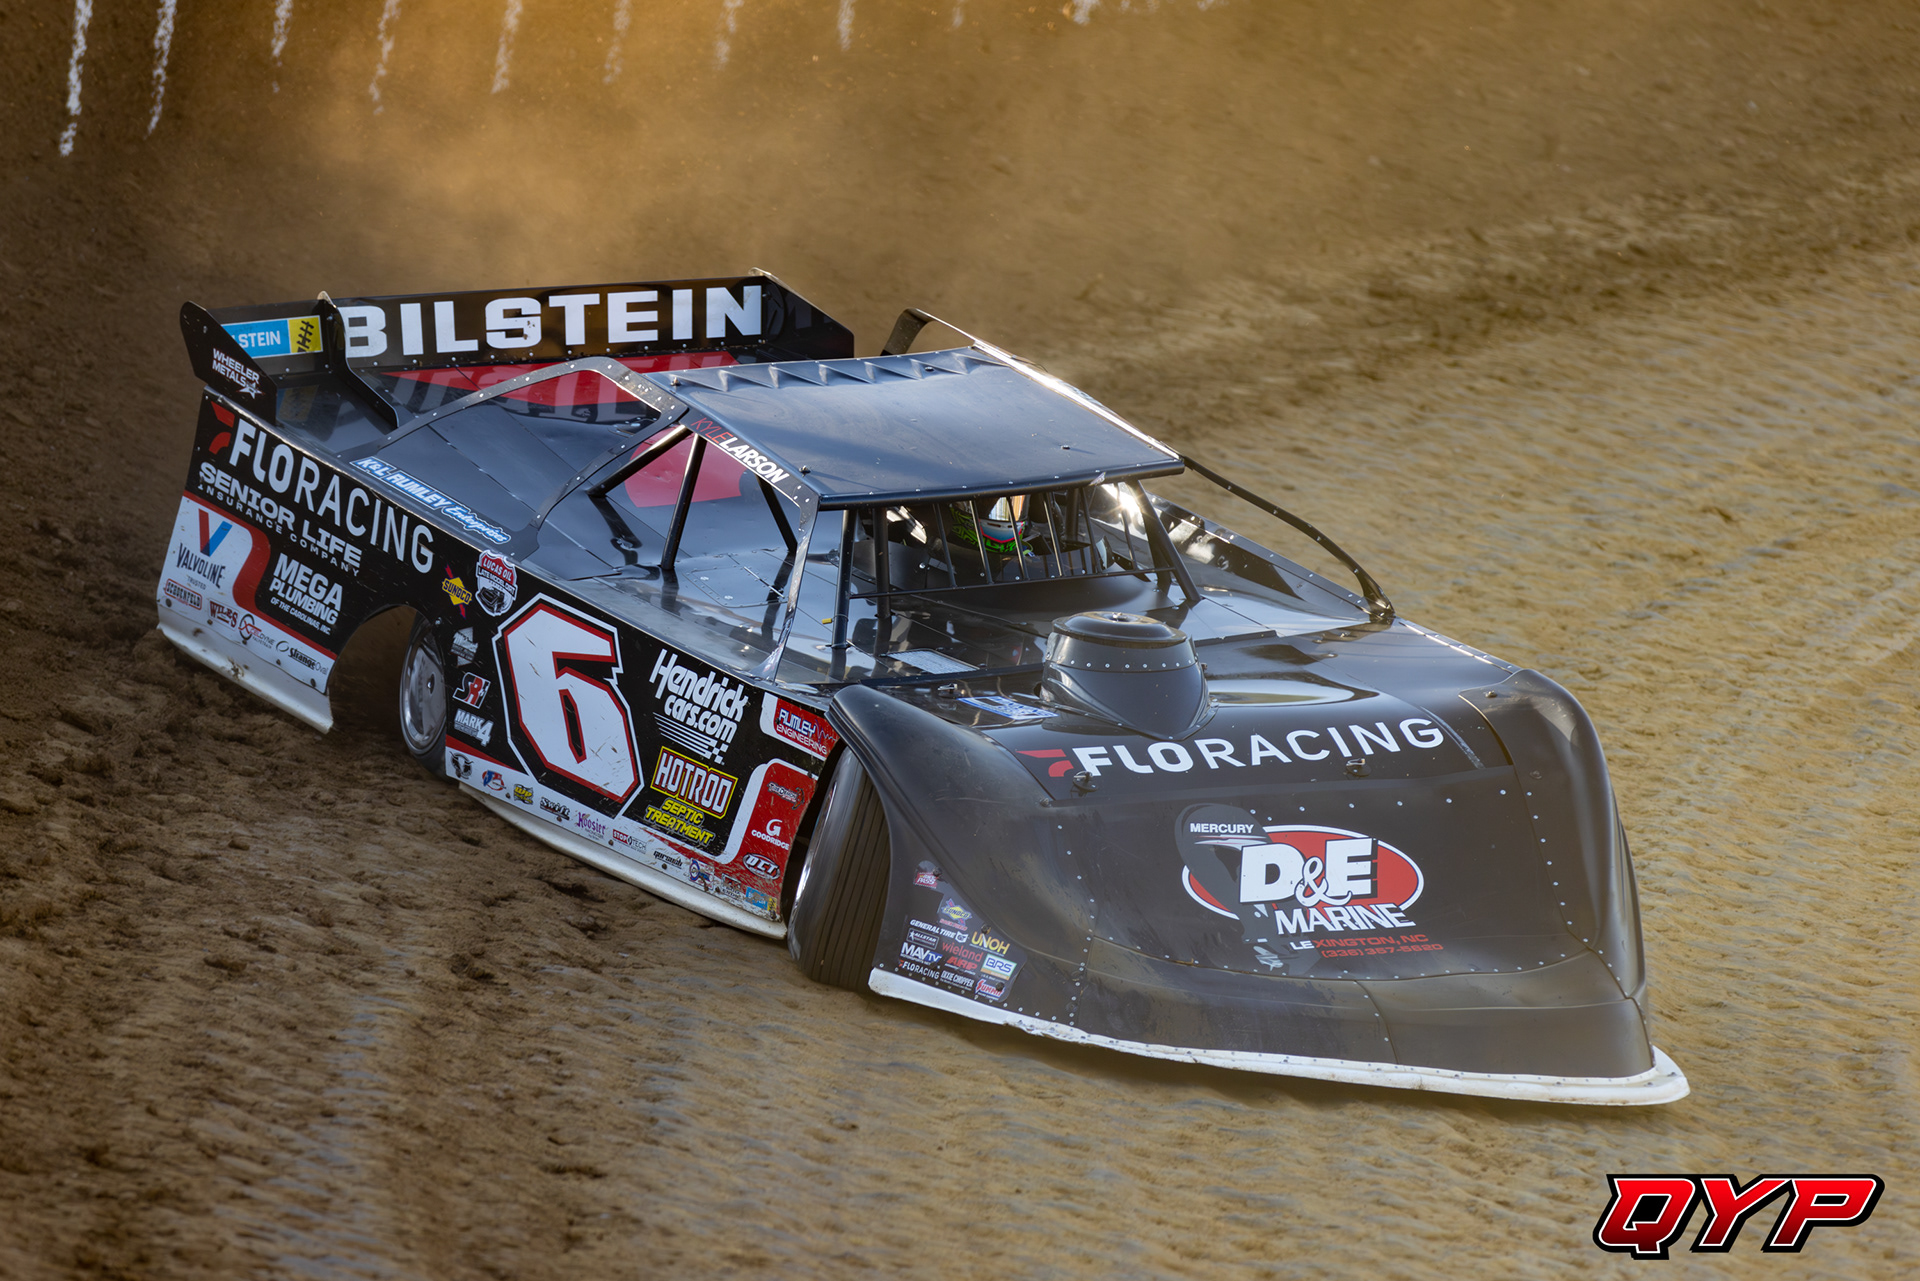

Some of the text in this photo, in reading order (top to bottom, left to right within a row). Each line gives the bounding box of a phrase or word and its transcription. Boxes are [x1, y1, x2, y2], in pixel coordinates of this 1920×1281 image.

[337, 286, 762, 358] BILSTEIN
[231, 330, 281, 349] STEIN
[212, 348, 260, 384] WHEELER
[212, 360, 247, 388] METALS
[229, 417, 435, 574] FLORACING
[356, 458, 390, 477] K&L
[385, 472, 453, 508] RUMLEY
[200, 462, 363, 569] SENIOR LIFE
[198, 484, 360, 578] INSURANCE COMPANY
[176, 542, 226, 589] VALVOLINE
[483, 557, 512, 582] LUCAS OIL
[166, 581, 202, 608] SCHOENFELD
[273, 552, 343, 612] MEGA
[443, 580, 472, 603] SUNOCO
[209, 600, 239, 628] WILES
[269, 577, 339, 626] PLUMBING
[270, 597, 280, 608] OF
[280, 602, 291, 613] THE
[648, 648, 750, 723] Hendrick
[505, 603, 638, 803] 6
[664, 694, 738, 744] cars.com
[779, 708, 817, 736] RUMLEY
[776, 723, 828, 756] ENGINEERING
[1072, 717, 1446, 778] FLORACING
[576, 811, 607, 837] Hoosier
[645, 806, 715, 845] TREATMENT
[661, 798, 704, 825] SEPTIC
[751, 829, 790, 851] GOODRIDGE
[1190, 823, 1254, 835] MERCURY
[1239, 837, 1374, 908] D&E
[943, 906, 971, 919] SUNOCO
[1274, 902, 1417, 935] MARINE
[910, 919, 957, 939] GENERAL TIRE
[914, 932, 937, 943] ALLSTAR
[971, 931, 1011, 955] UNOH
[1401, 933, 1430, 944] NC
[942, 942, 984, 963] wieland
[946, 956, 978, 970] ARP
[985, 957, 1013, 973] BRS
[1321, 949, 1365, 959] (336)
[902, 960, 940, 980] FLORACING
